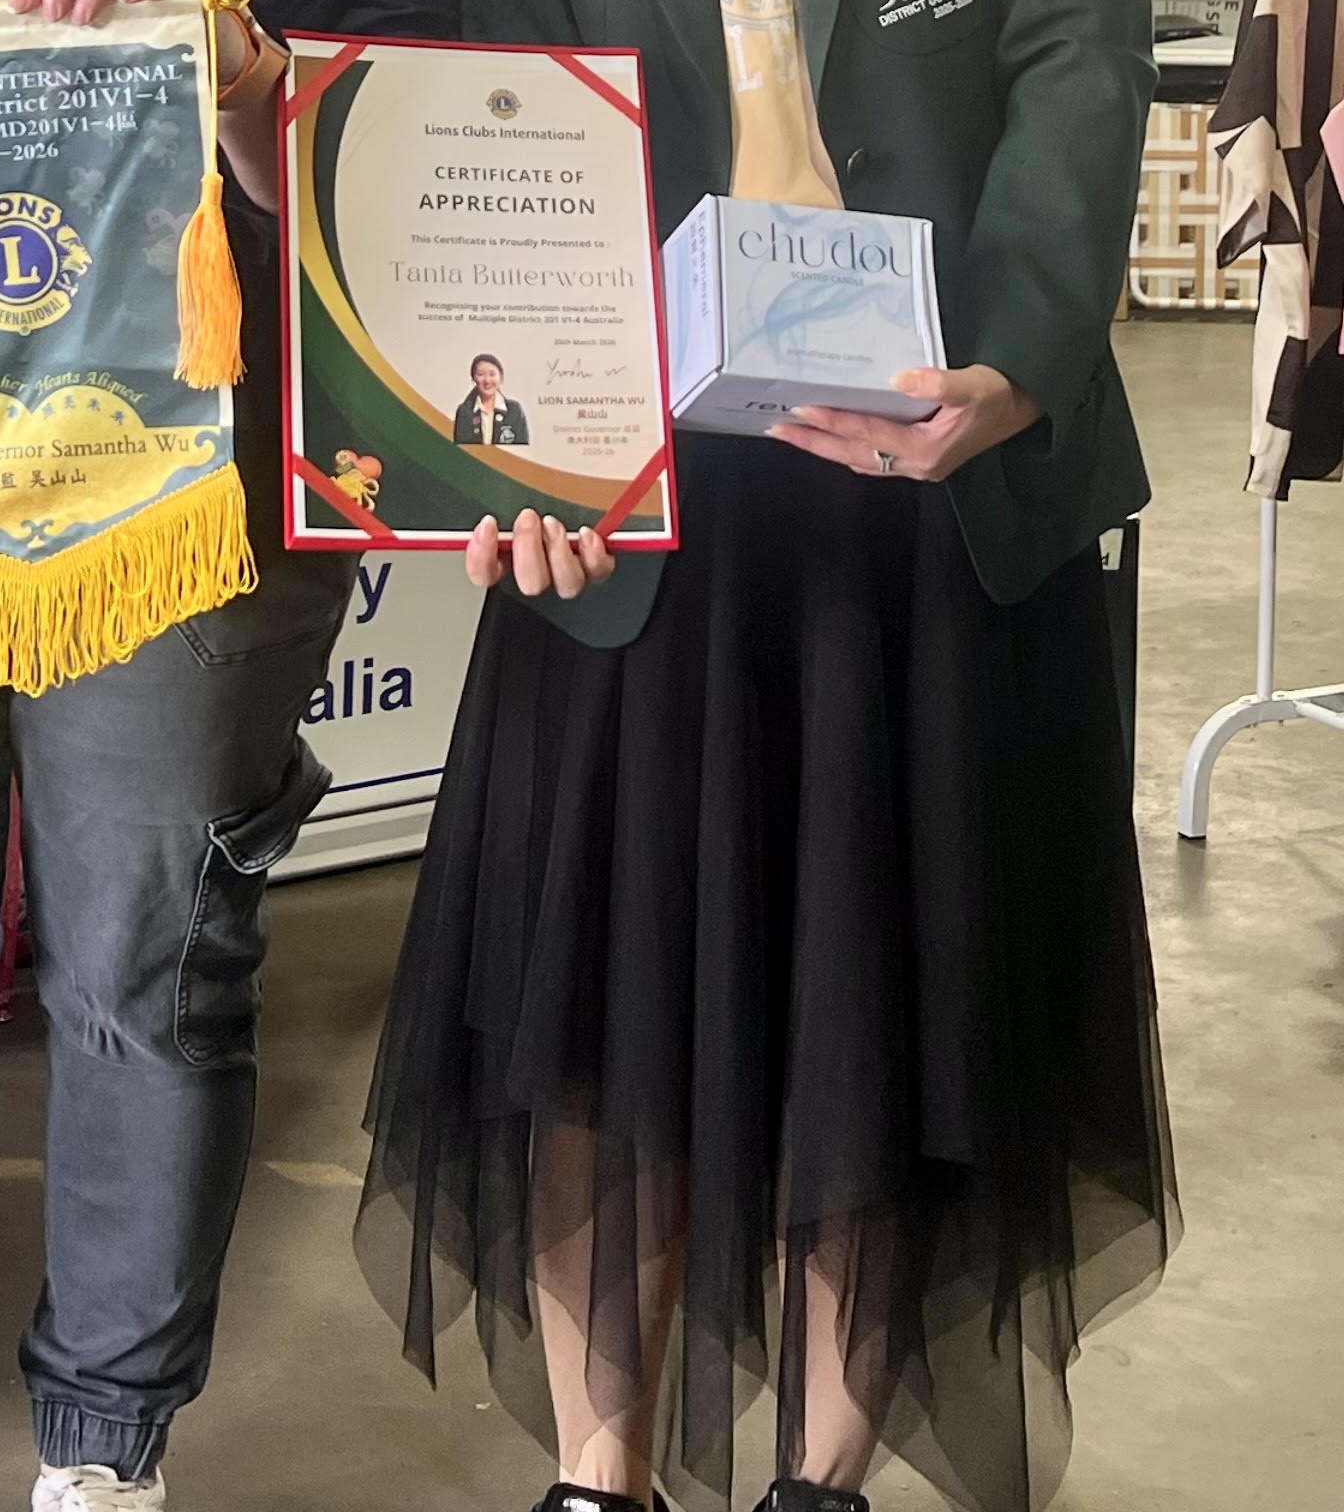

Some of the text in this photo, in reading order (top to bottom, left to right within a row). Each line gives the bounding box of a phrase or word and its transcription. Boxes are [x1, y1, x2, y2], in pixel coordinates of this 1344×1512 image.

[58, 85, 169, 110] 201V1-4
[424, 123, 586, 142] Lions Clubs International
[435, 166, 585, 184] CERTIFICATE OF
[419, 193, 595, 215] APPRECIATION
[411, 234, 605, 249] This Certificate is Proudly Presented to
[389, 261, 635, 288] Tania Butterworth
[35, 371, 81, 396] Hearts
[86, 370, 147, 405] Aligned
[538, 396, 645, 405] LION SAMANTHA WU
[52, 438, 147, 460] Samantha
[155, 434, 190, 453] Wu
[302, 658, 412, 724] alia
